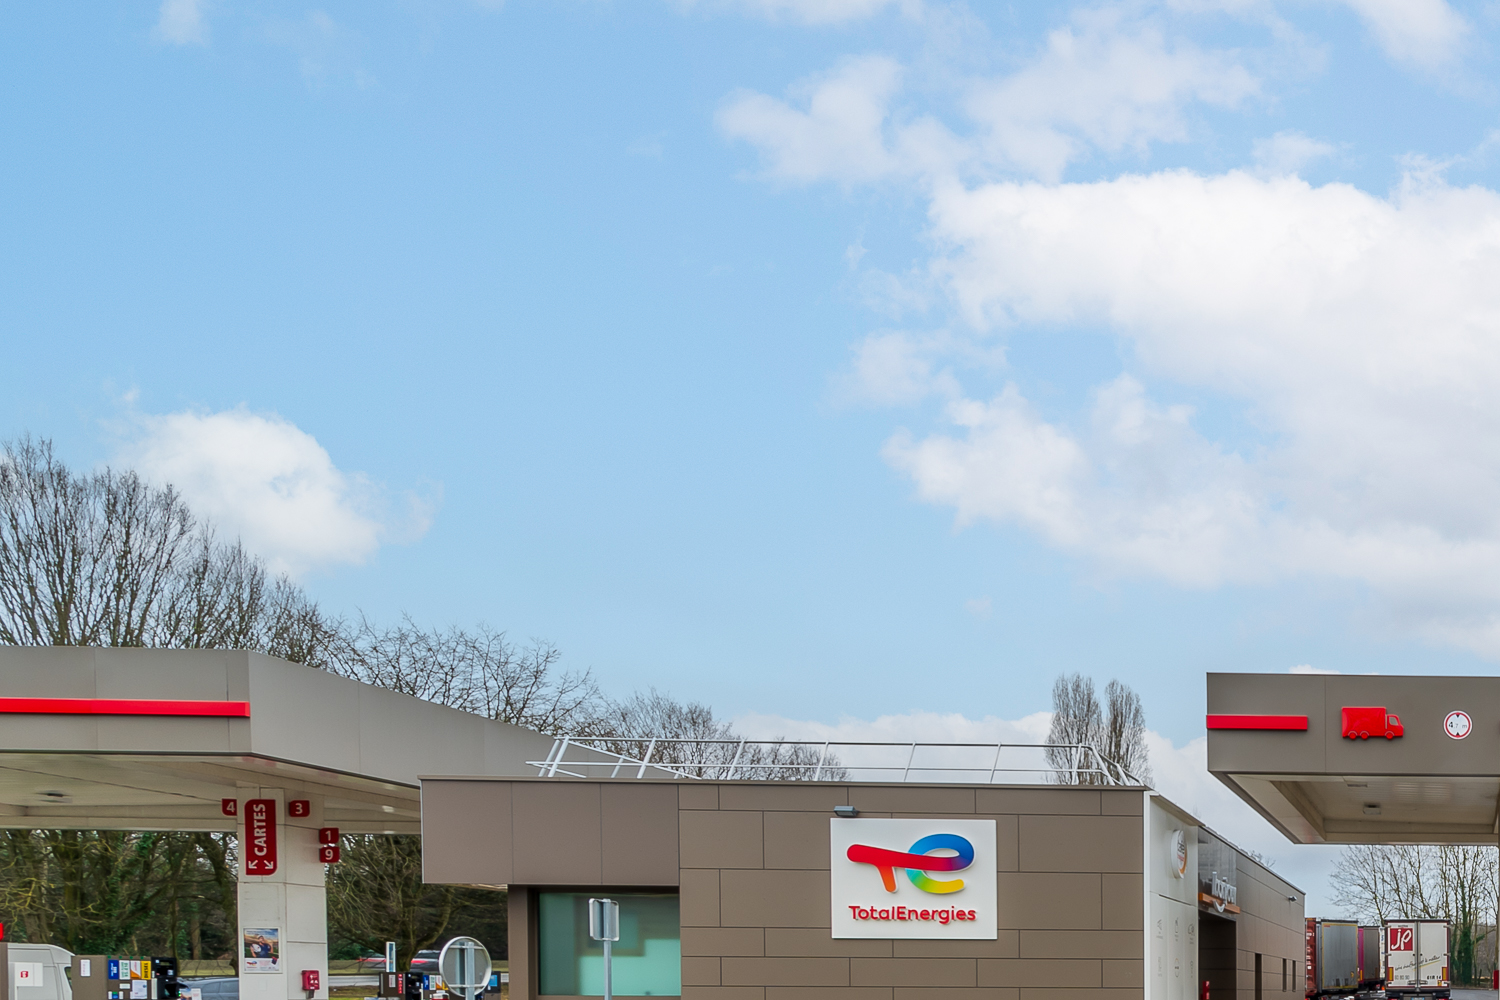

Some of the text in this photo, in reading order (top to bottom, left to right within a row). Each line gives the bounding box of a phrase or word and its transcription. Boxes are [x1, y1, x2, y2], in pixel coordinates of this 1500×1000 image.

[226, 801, 235, 812] 4
[295, 803, 303, 814] 3
[253, 803, 267, 856] CARTES
[325, 830, 331, 841] 1
[325, 849, 333, 860] 9
[848, 905, 977, 924] TotalEnergies
